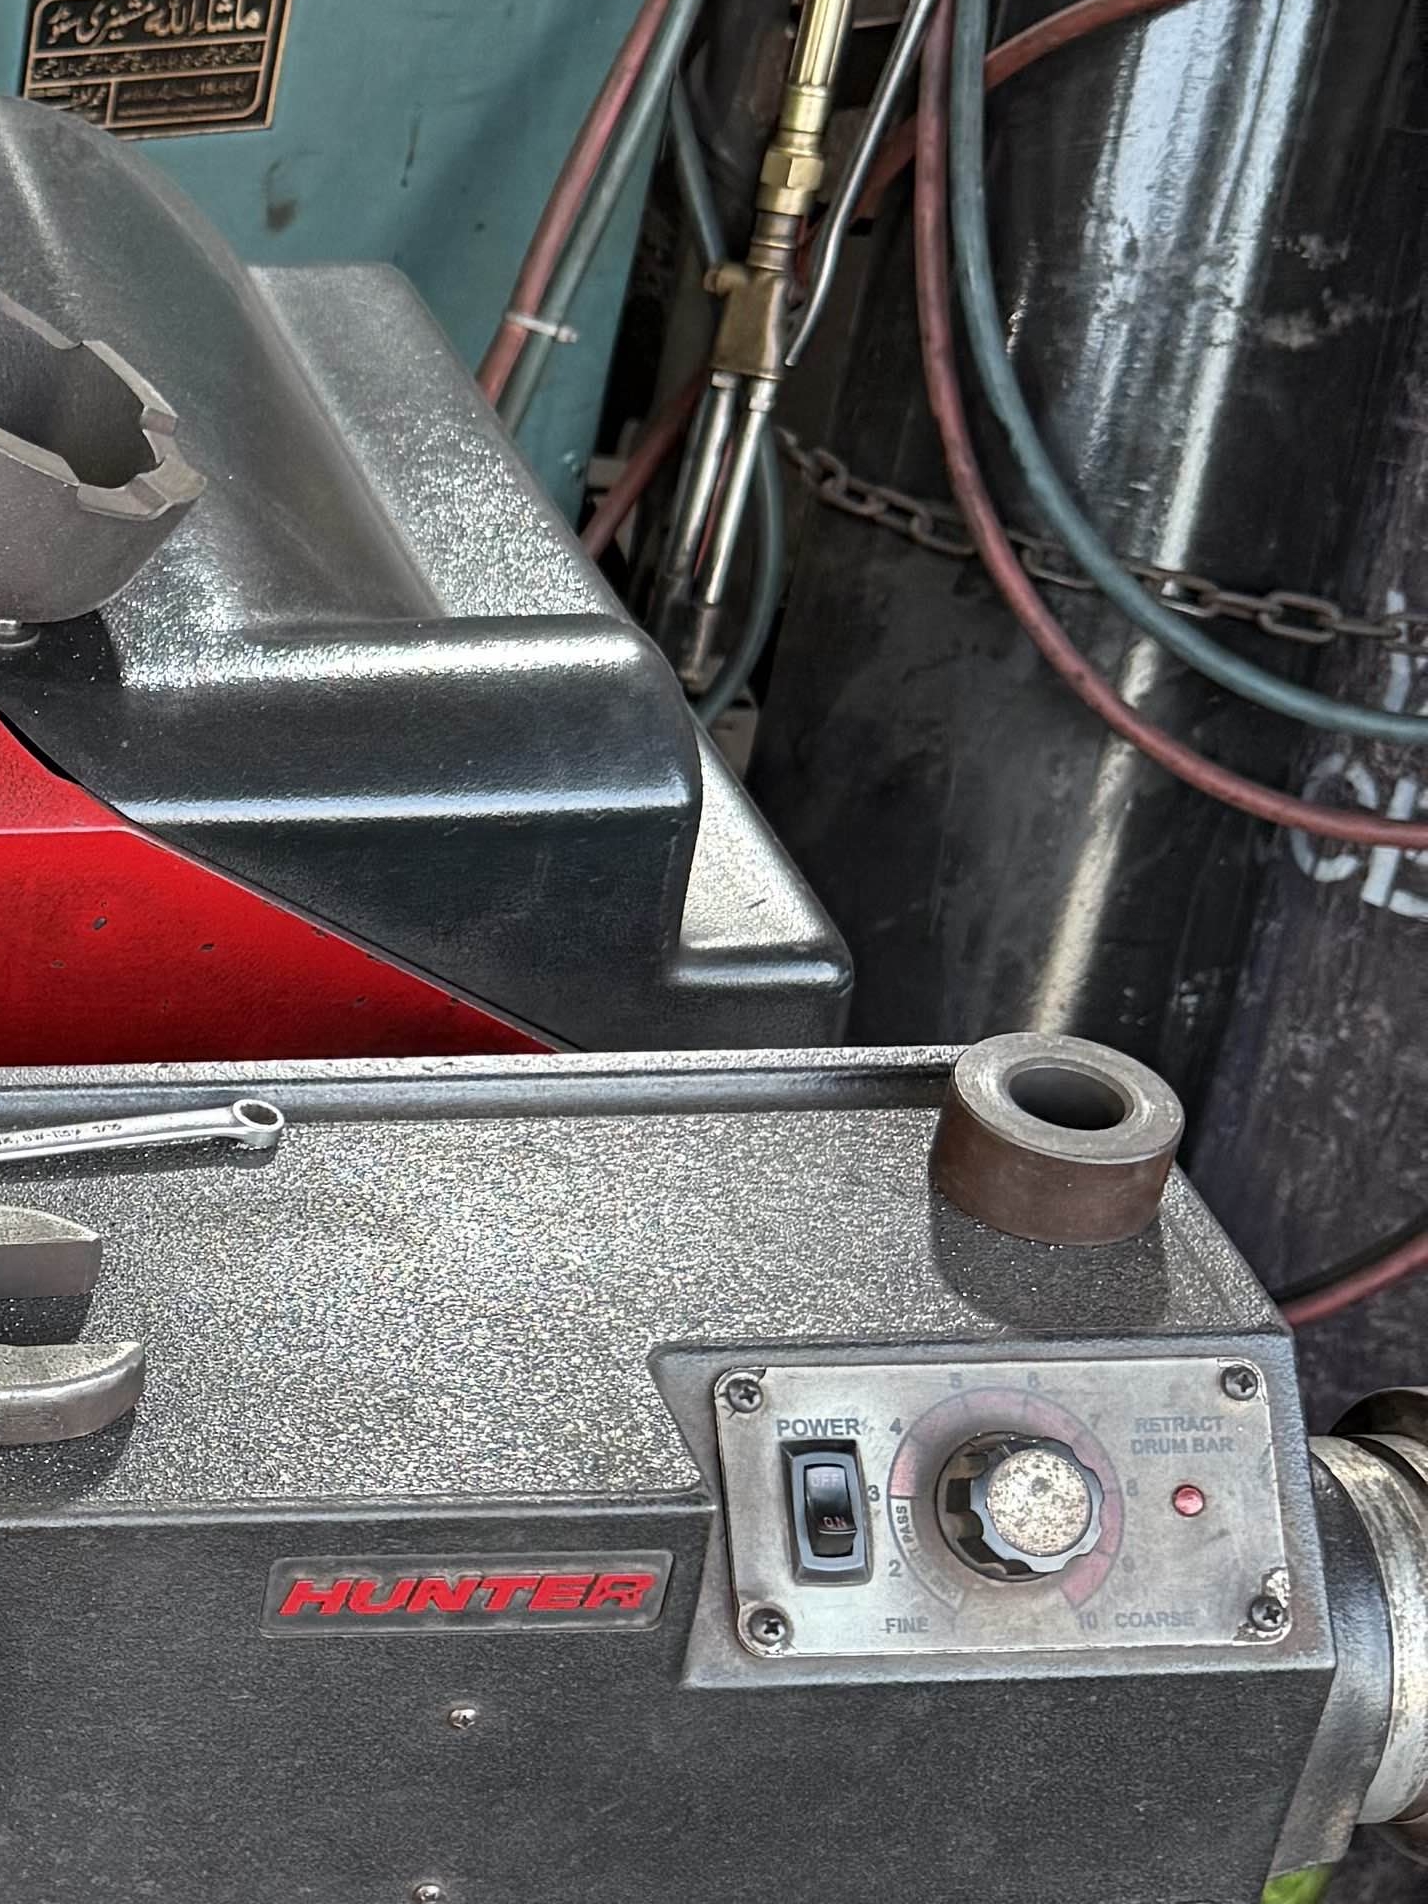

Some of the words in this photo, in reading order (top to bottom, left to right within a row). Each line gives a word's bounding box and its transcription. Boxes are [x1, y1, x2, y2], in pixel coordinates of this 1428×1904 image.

[776, 1417, 861, 1437] POWER
[889, 1417, 903, 1436] 4
[1135, 1415, 1226, 1434] RETRACT
[1130, 1437, 1189, 1455] DRUM
[1192, 1435, 1236, 1454] BAR
[810, 1473, 841, 1487] OFF
[1126, 1478, 1139, 1496] 8
[868, 1484, 881, 1502] 3
[822, 1516, 848, 1529] ON
[895, 1505, 915, 1544] PASS
[888, 1559, 901, 1578] 2
[277, 1572, 657, 1617] HUNTER
[884, 1616, 930, 1635] FINE
[1077, 1611, 1098, 1630] 10
[1114, 1610, 1197, 1629] COARSE
